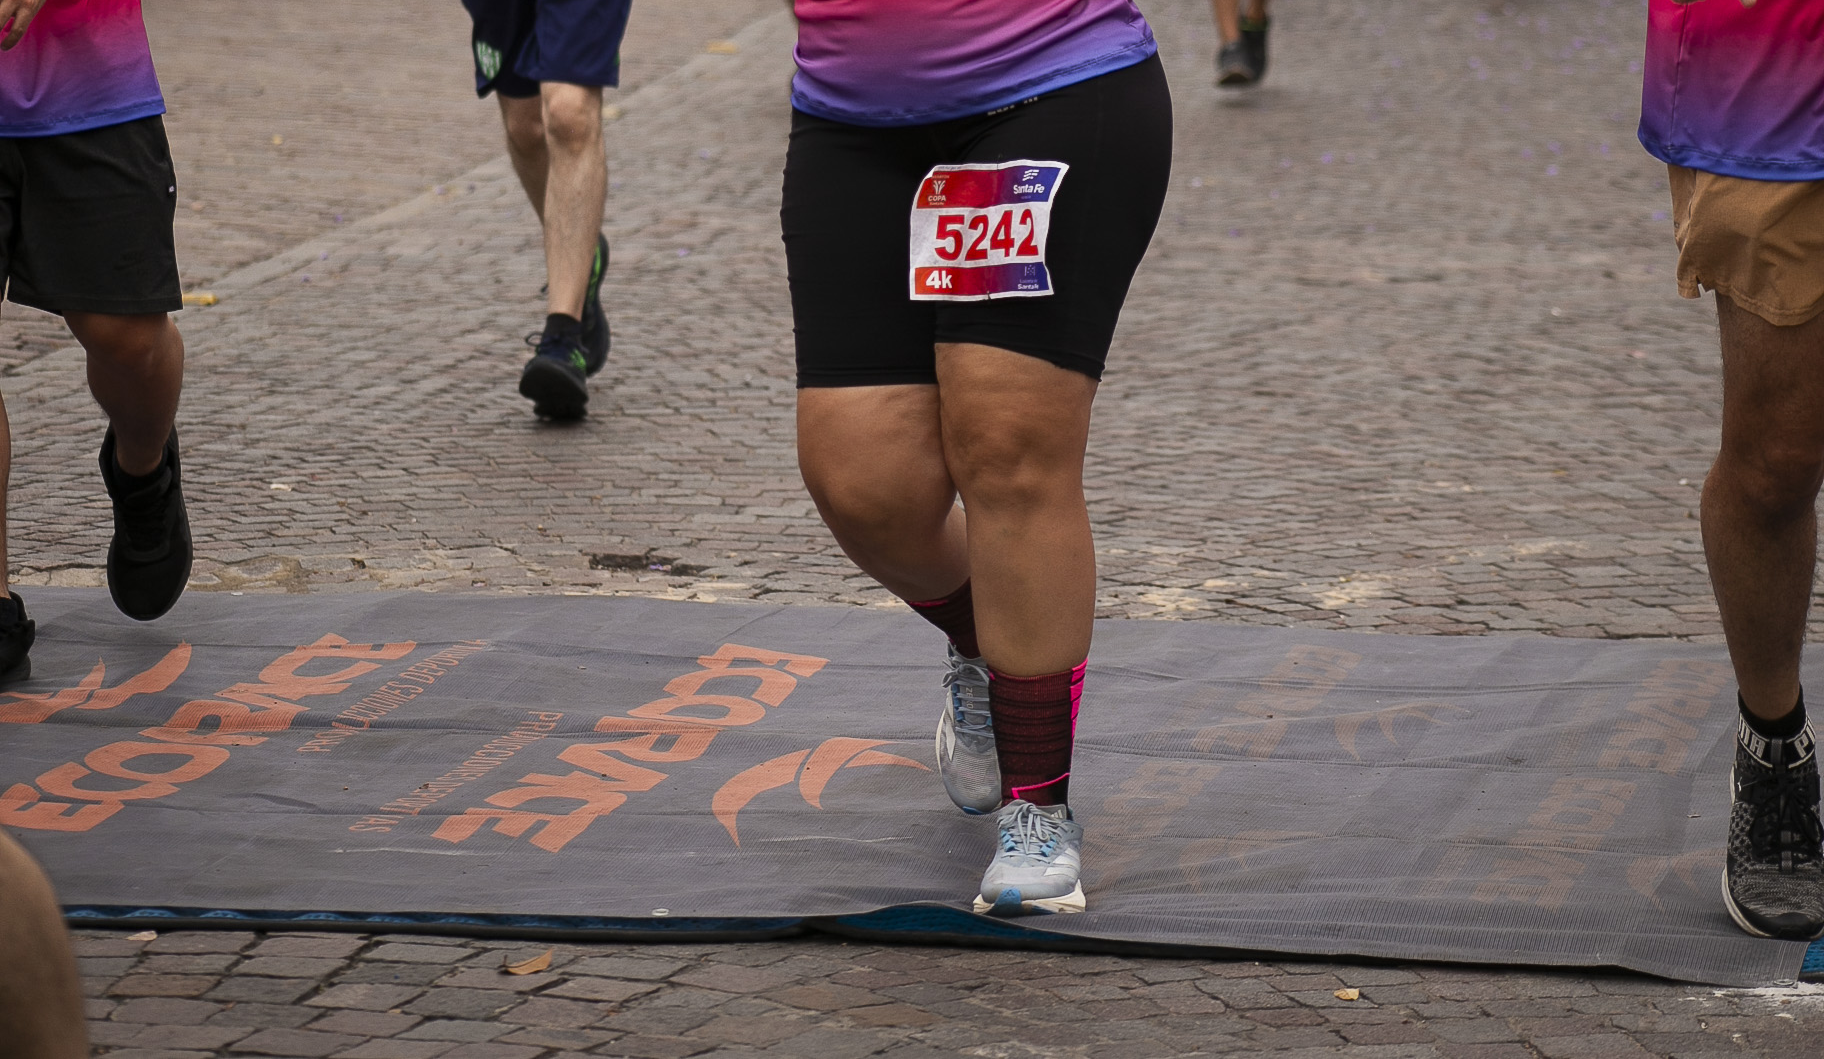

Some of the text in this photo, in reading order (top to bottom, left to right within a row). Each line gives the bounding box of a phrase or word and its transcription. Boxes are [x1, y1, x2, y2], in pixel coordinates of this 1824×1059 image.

[1013, 183, 1045, 195] Santa Fe
[934, 208, 1039, 262] 5242
[925, 270, 953, 290] 4k
[0, 632, 417, 832] ECORACE
[430, 643, 831, 853] ECORACE
